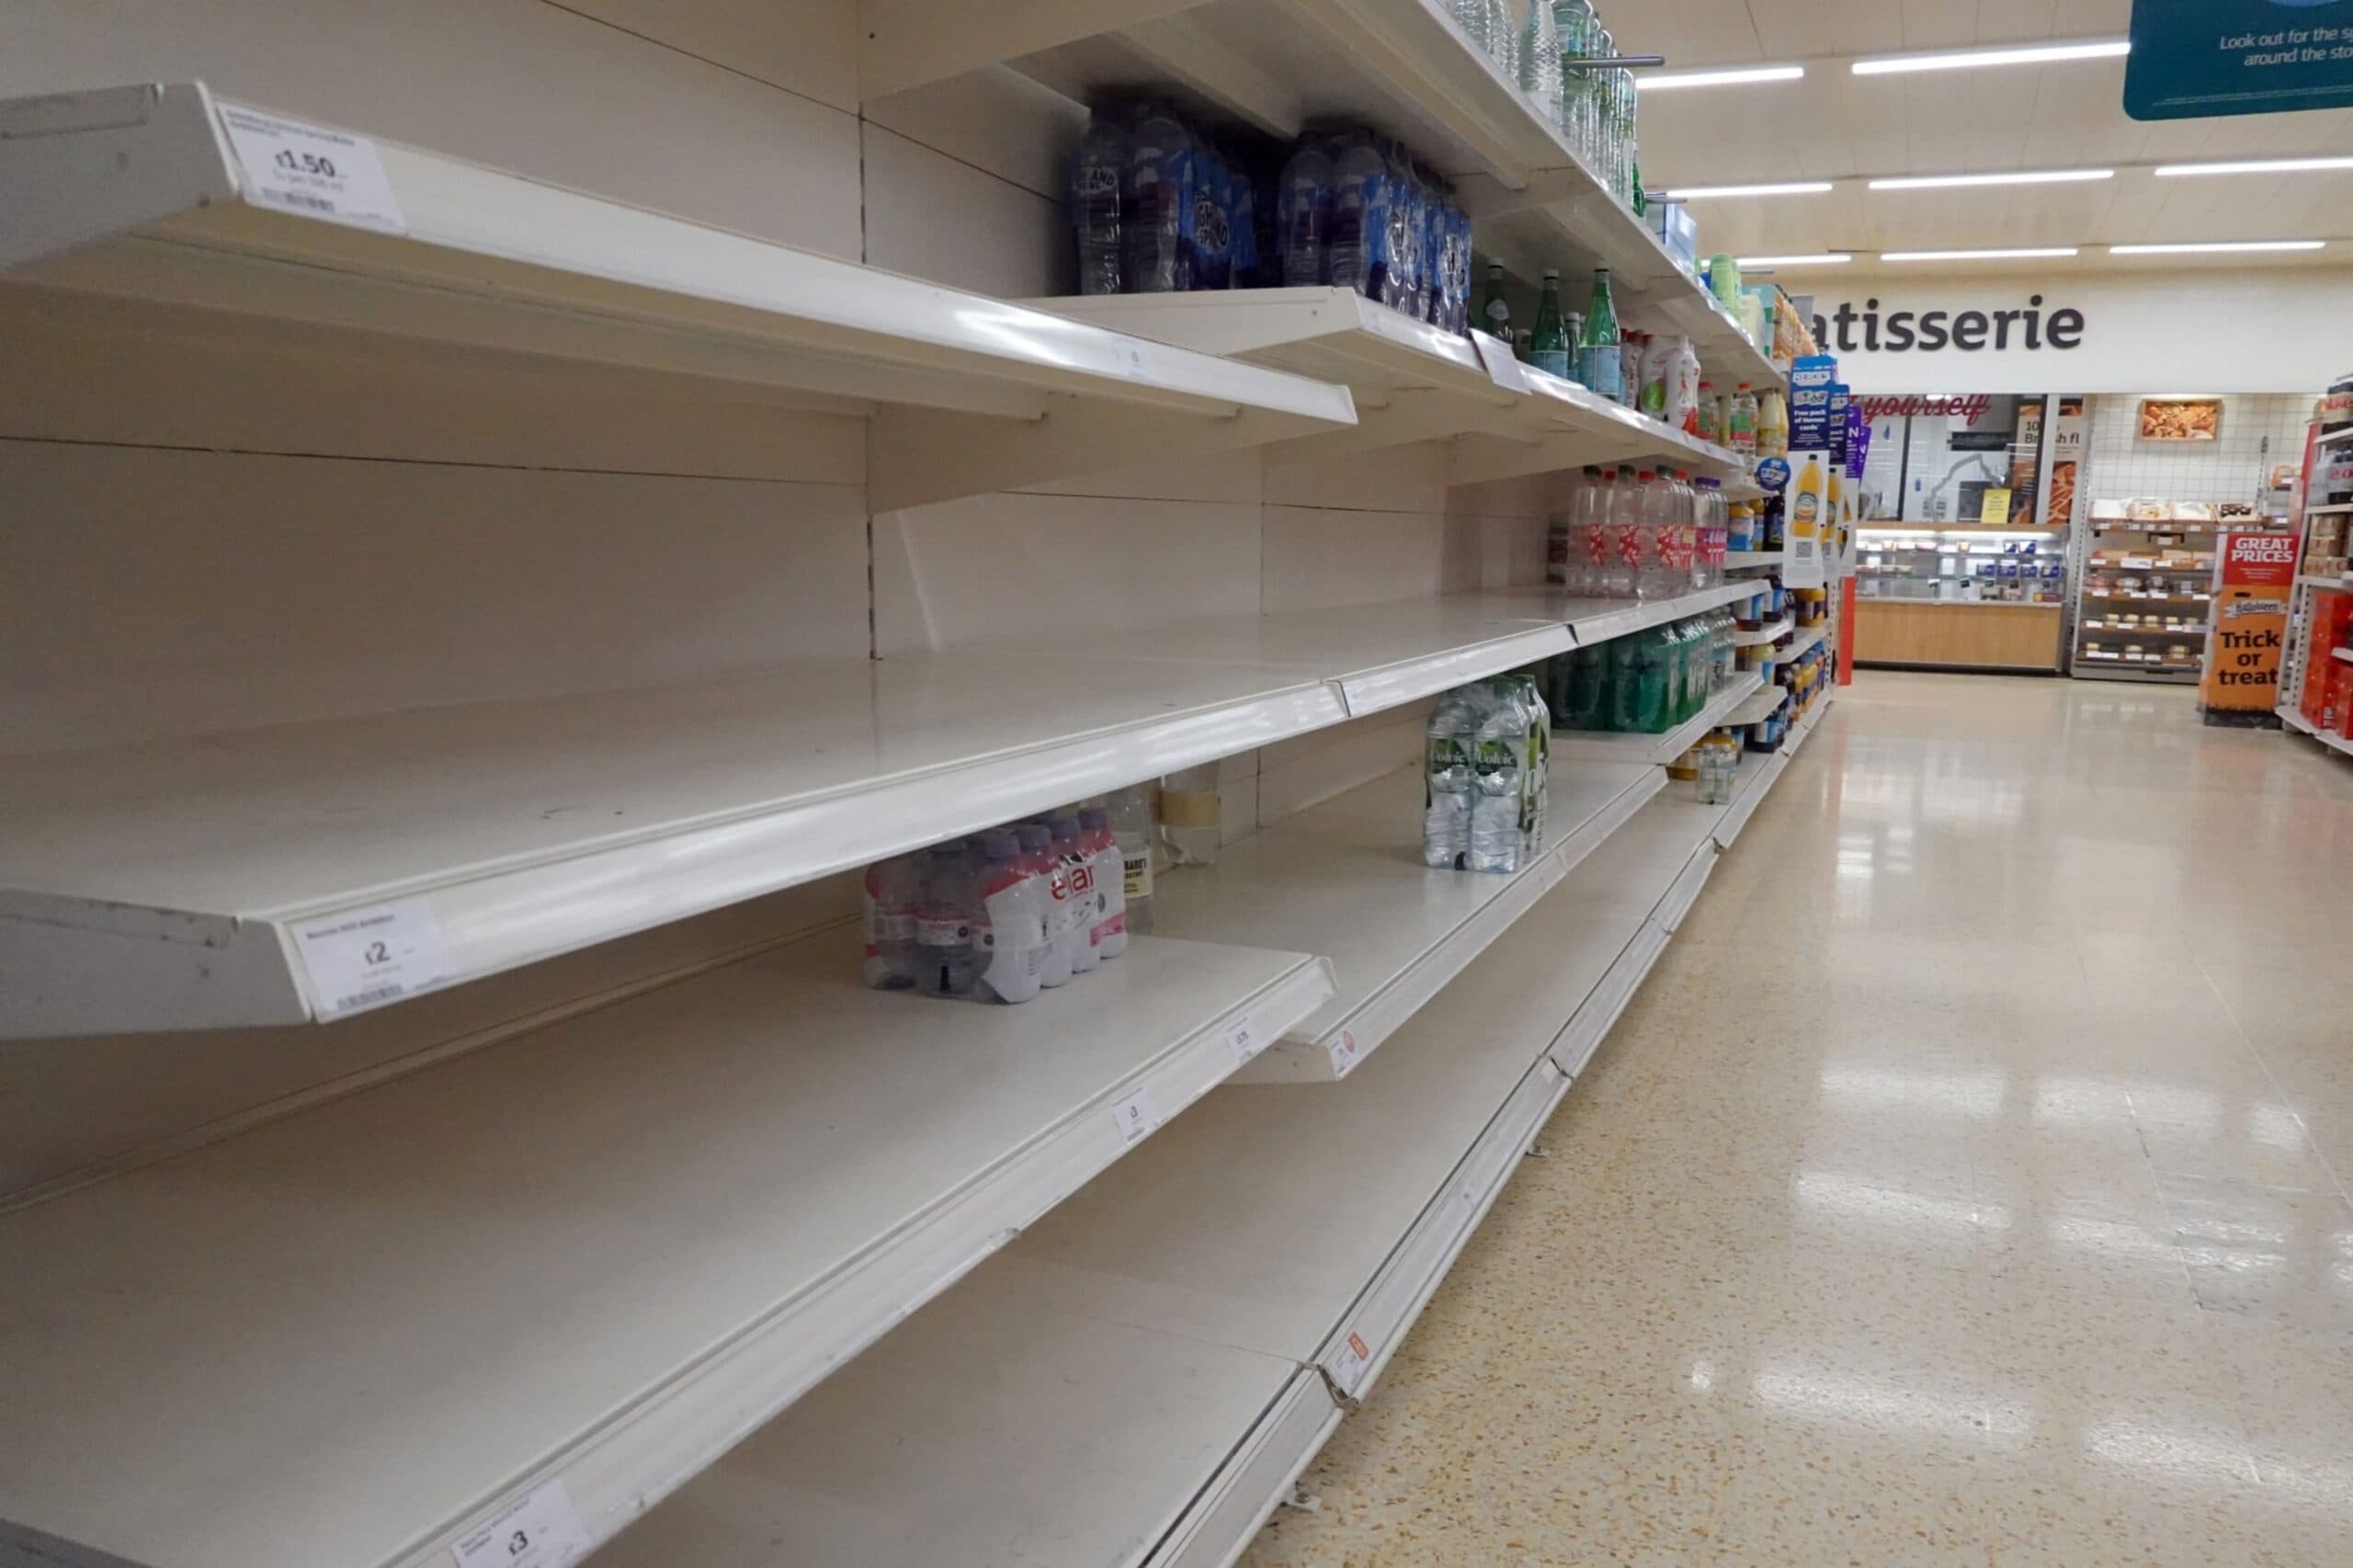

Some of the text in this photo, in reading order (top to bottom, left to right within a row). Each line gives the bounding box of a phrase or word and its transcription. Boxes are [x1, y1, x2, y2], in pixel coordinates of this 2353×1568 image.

[2220, 33, 2256, 49] Look
[2258, 31, 2285, 46] out
[2287, 29, 2309, 43] for
[2313, 27, 2338, 41] the
[2244, 49, 2298, 66] around
[2302, 47, 2326, 62] the
[275, 149, 335, 177] £1.50
[1812, 294, 2085, 352] atisserie
[1863, 394, 1992, 426] yourself
[2235, 537, 2292, 551] GREAT
[2231, 550, 2294, 563] PRICES
[2220, 629, 2280, 649] Trick
[2237, 653, 2262, 667] or
[2219, 668, 2279, 686] treat
[365, 941, 390, 966] £2
